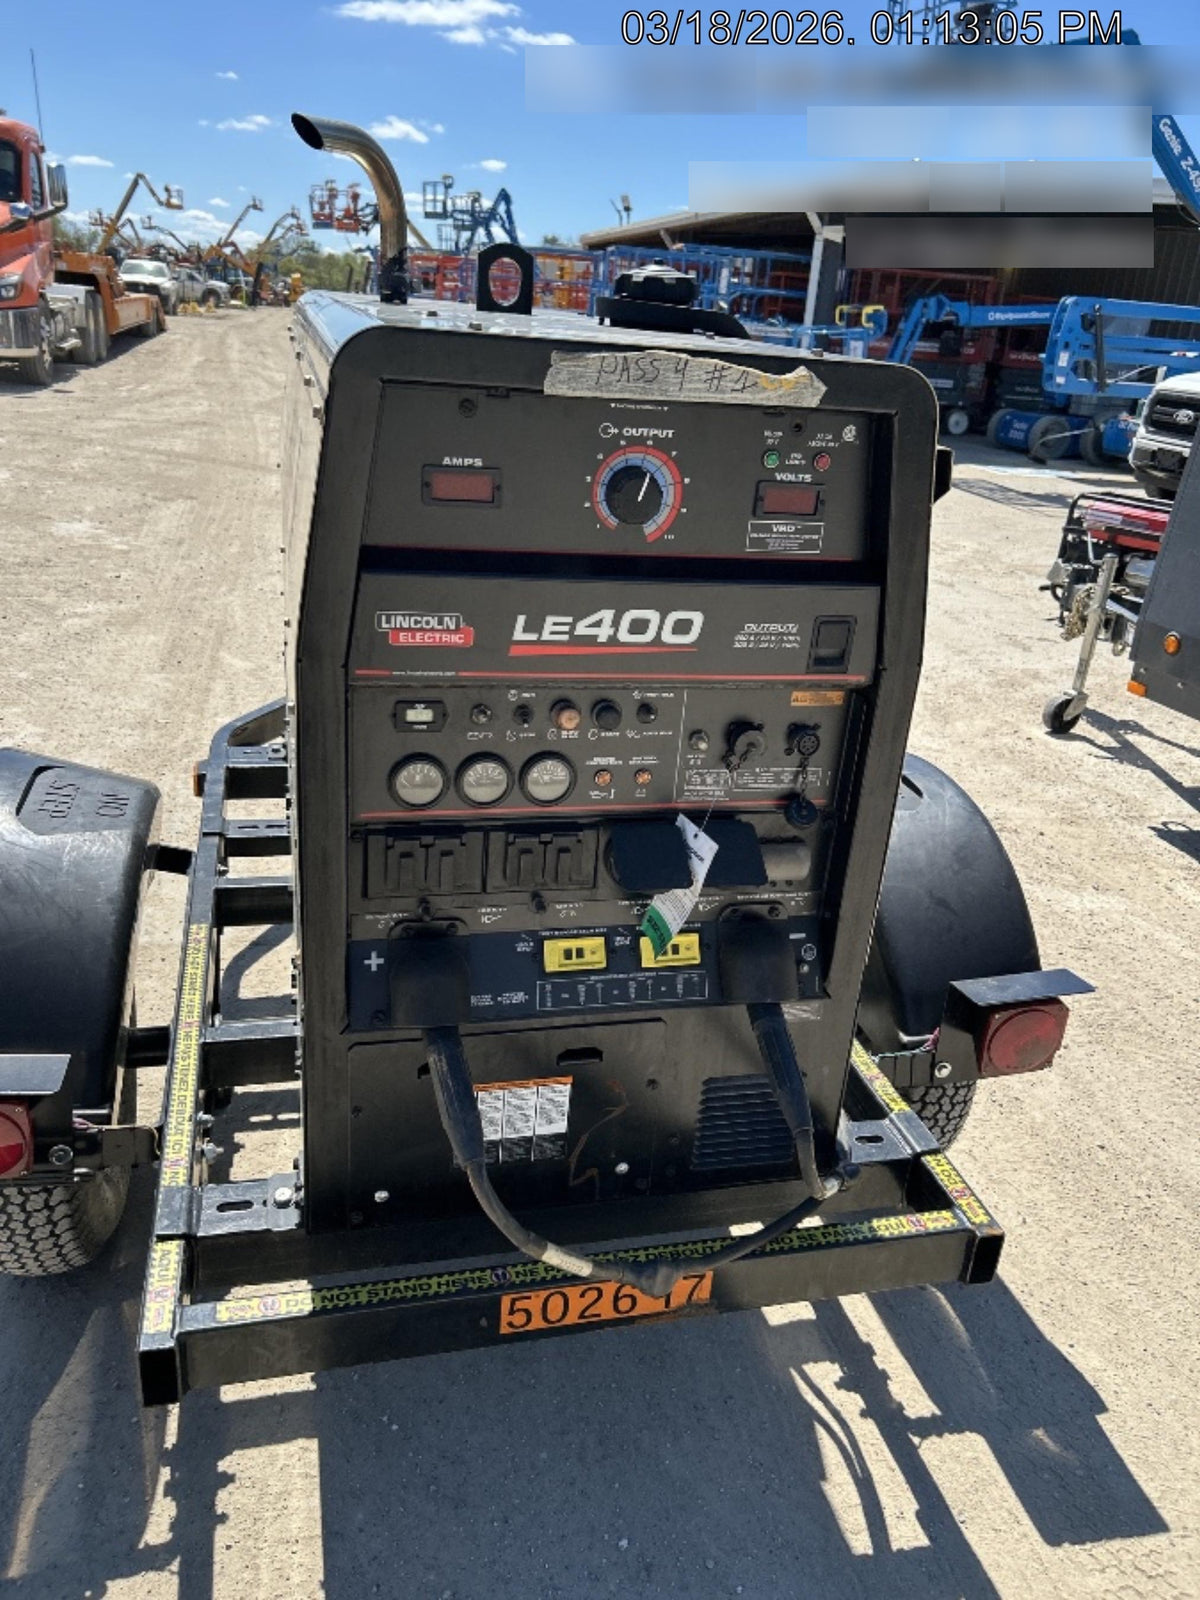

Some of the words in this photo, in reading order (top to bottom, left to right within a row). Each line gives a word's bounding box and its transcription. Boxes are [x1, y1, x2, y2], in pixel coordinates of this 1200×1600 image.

[1159, 118, 1183, 156] Genie
[623, 427, 676, 439] OUTPUT
[442, 456, 483, 467] AMPS
[775, 472, 813, 483] VOLTS
[381, 614, 457, 630] LINCOLN
[511, 608, 704, 644] LE400
[399, 631, 465, 644] ELECTRIC
[38, 779, 81, 819] STEP
[95, 790, 131, 818] NO
[768, 1234, 794, 1247] NO
[867, 1219, 907, 1236] AQUI
[514, 1267, 540, 1280] NE
[320, 1289, 362, 1303] NOT
[367, 1282, 432, 1298] STAND
[436, 1273, 489, 1290] HERE
[506, 1273, 707, 1330] 50267
